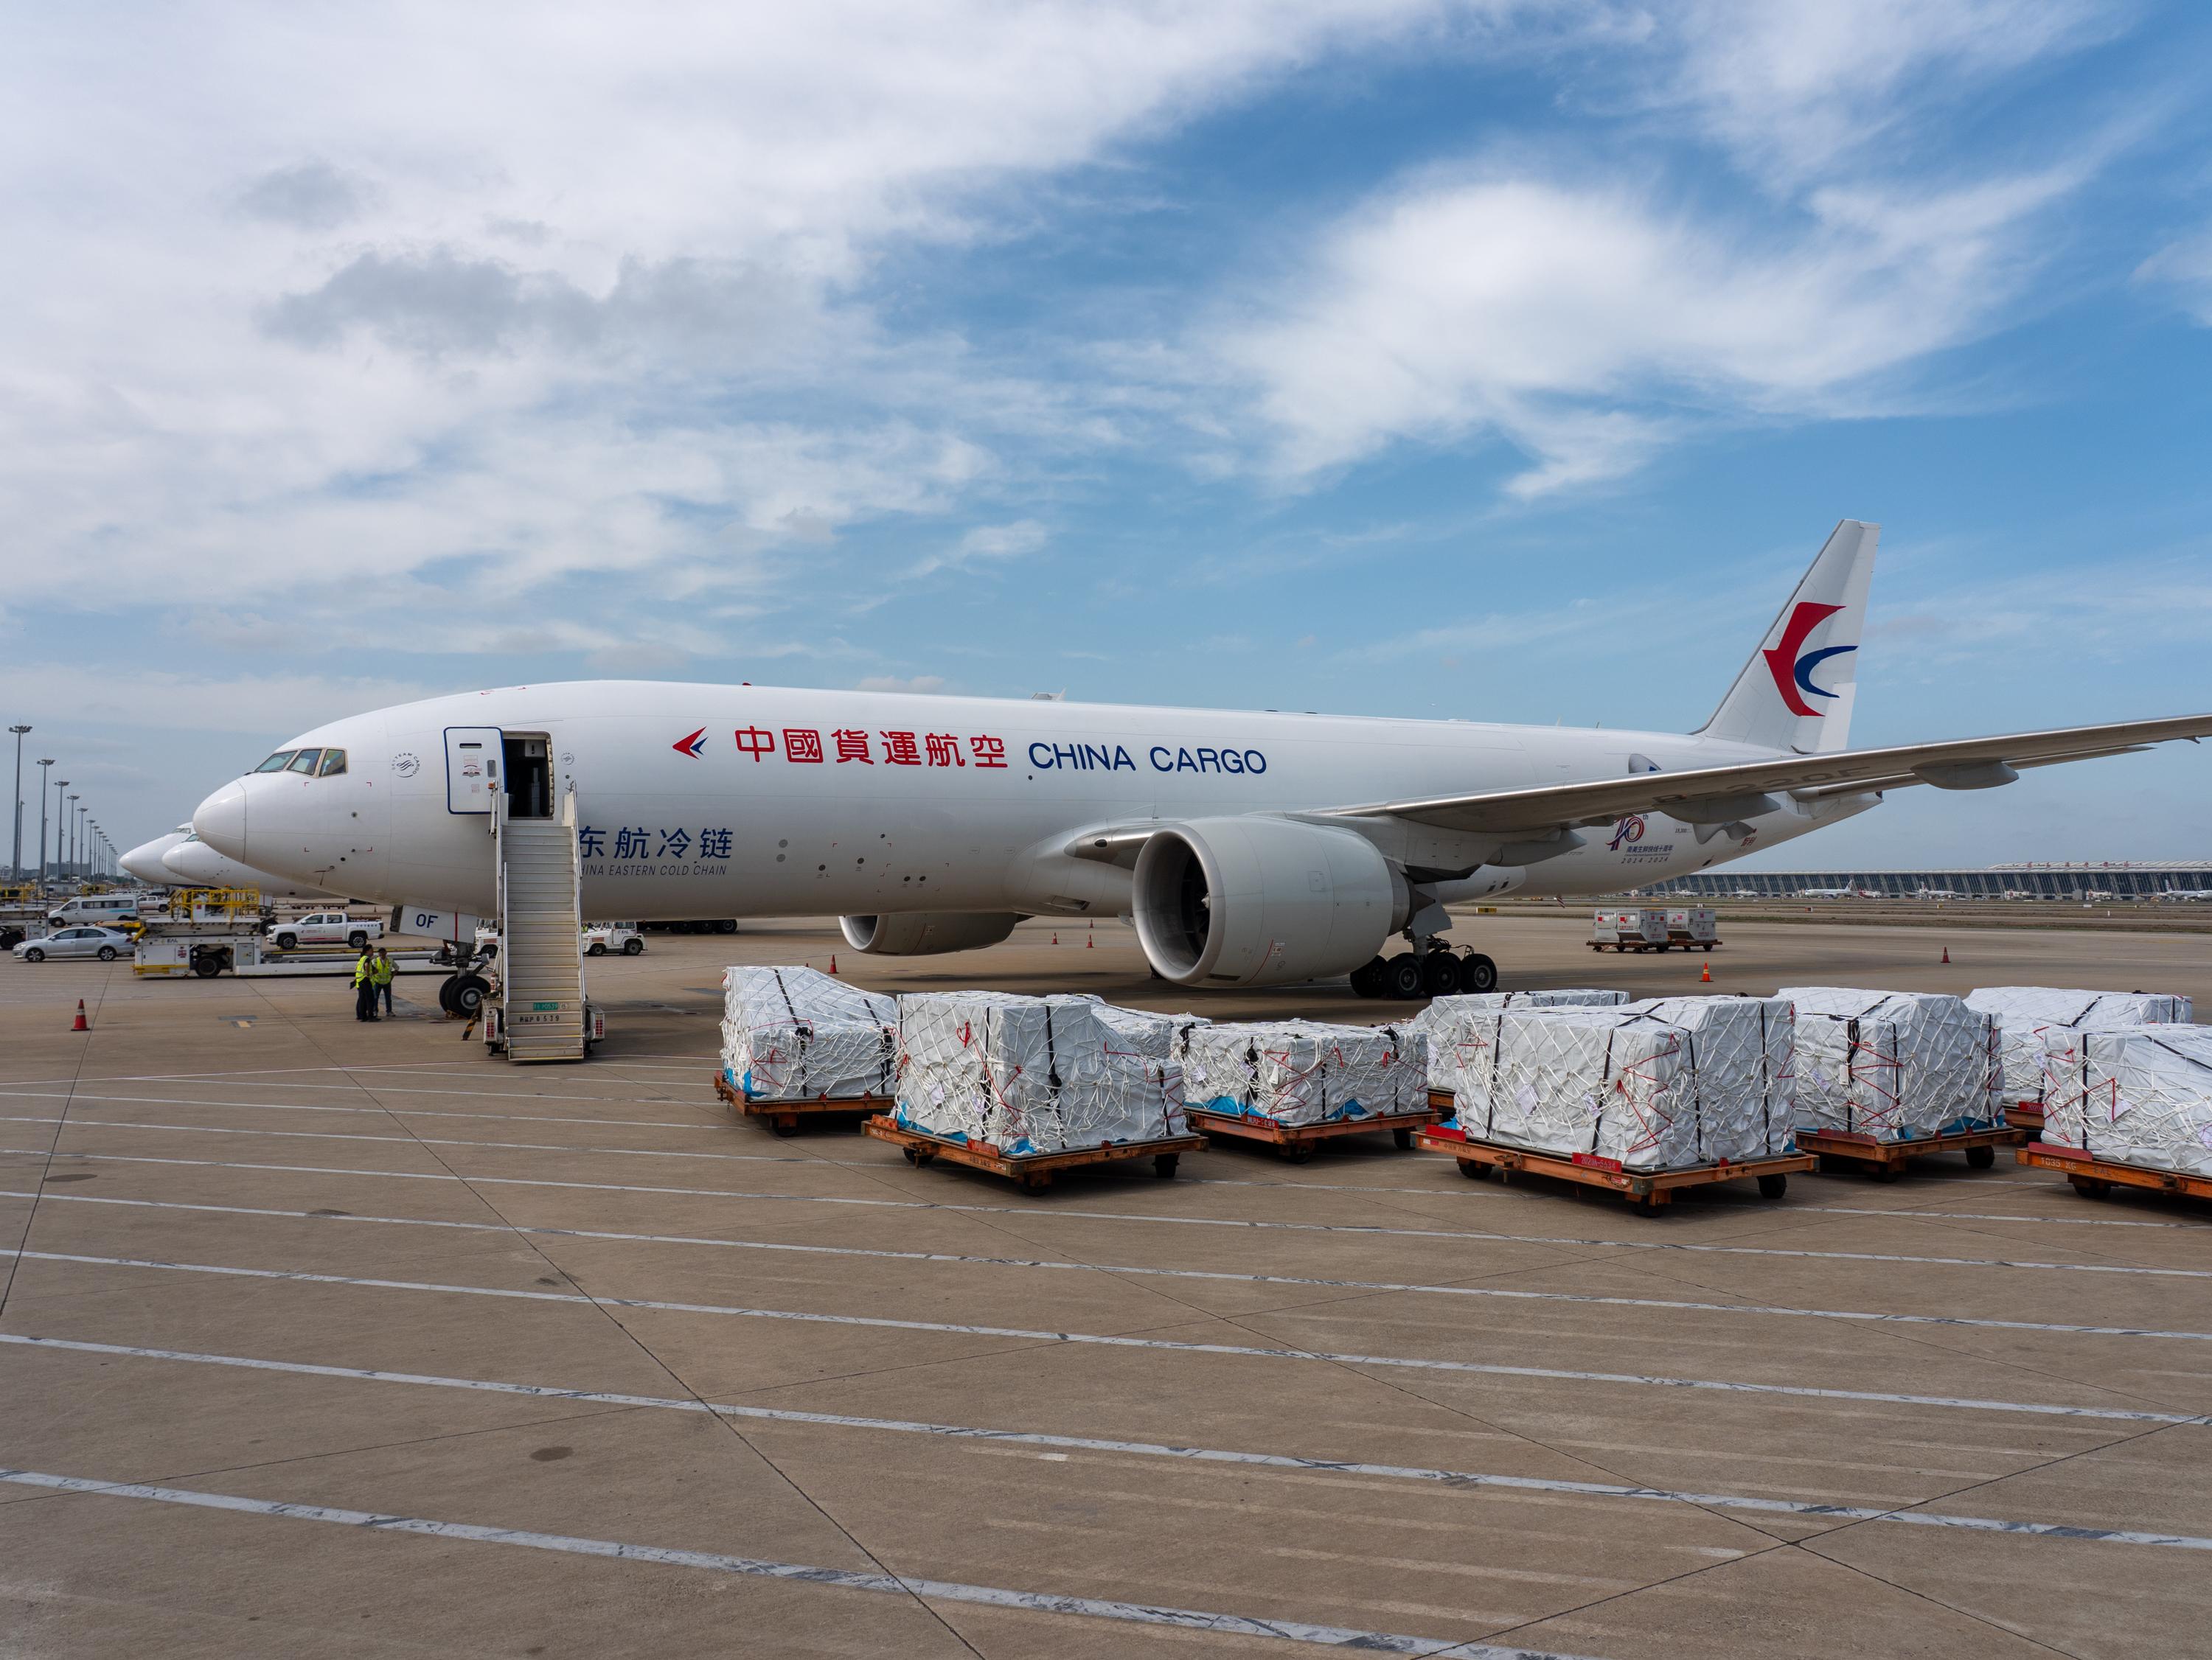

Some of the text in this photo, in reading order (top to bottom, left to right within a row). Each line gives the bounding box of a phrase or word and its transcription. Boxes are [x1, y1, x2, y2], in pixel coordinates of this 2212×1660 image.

[735, 725, 1008, 768] 中國貨運航空
[1029, 742, 1267, 774] CHINA CARGO
[412, 756, 420, 775] CARGO
[579, 826, 734, 859] 东航冷链
[581, 865, 727, 876] INA EASTERN COLD CHAIN
[2065, 1161, 2077, 1171] KG
